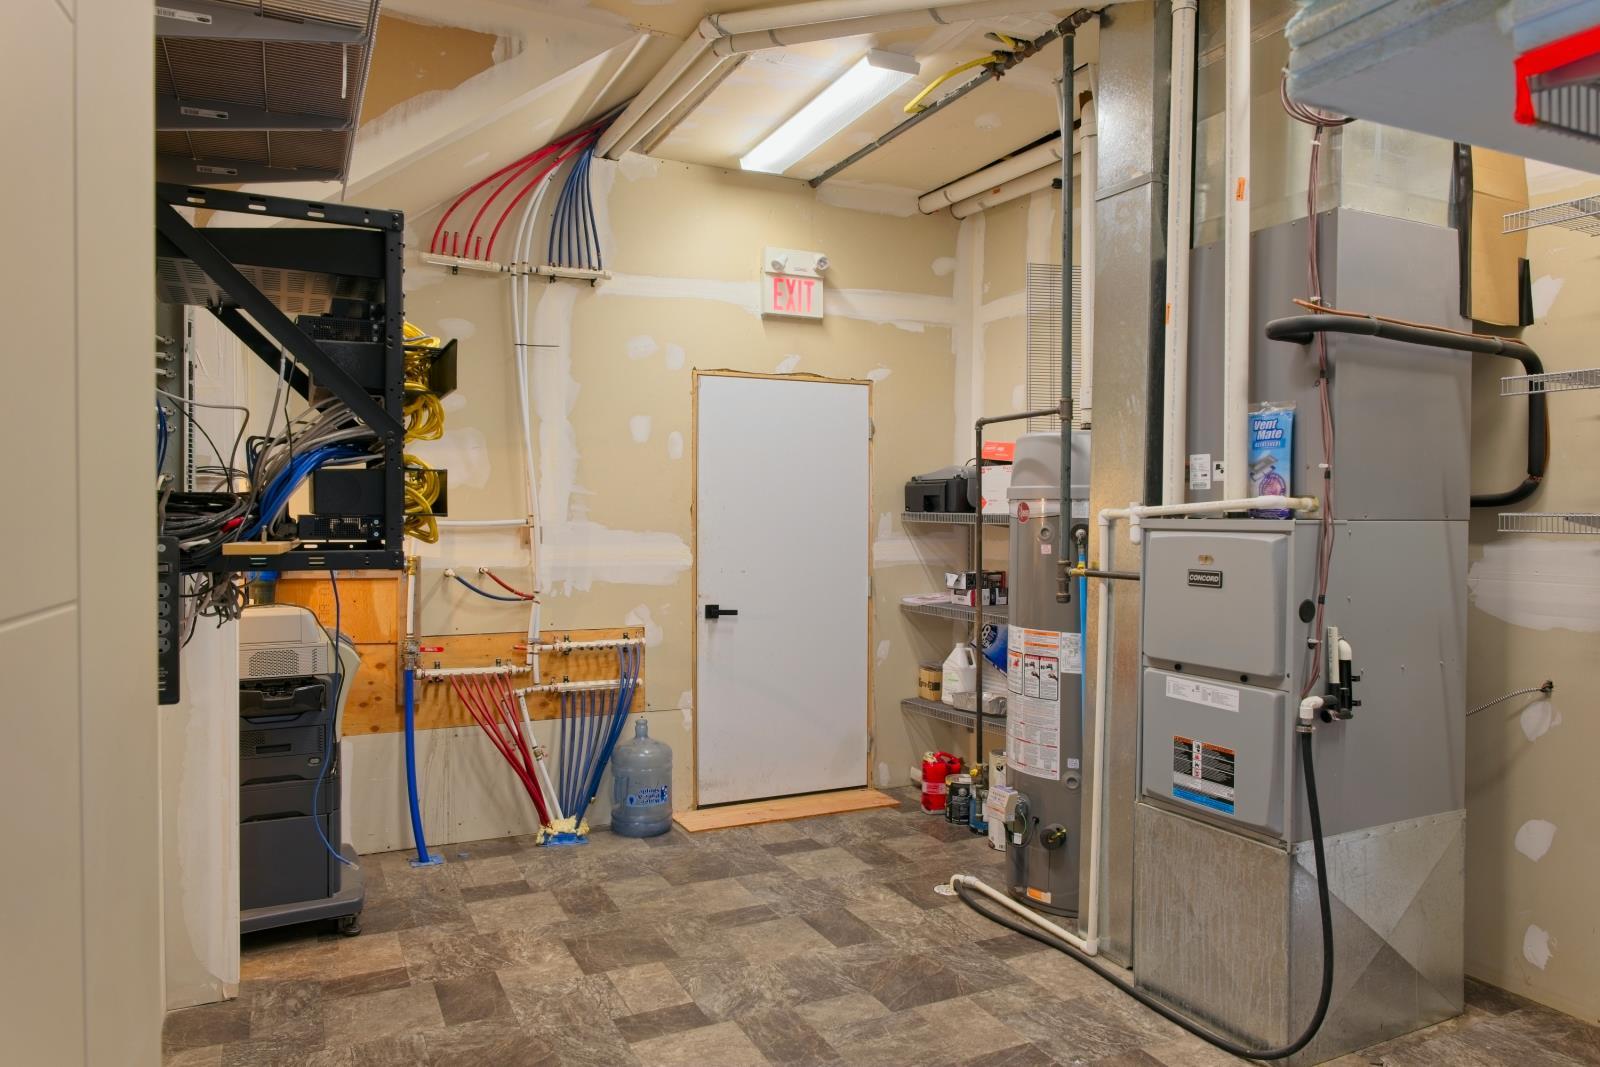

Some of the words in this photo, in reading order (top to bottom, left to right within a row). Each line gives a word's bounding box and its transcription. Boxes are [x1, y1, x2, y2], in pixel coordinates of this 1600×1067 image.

[773, 277, 814, 312] EXIT
[1254, 420, 1277, 430] Vent
[1257, 430, 1282, 440] Mate
[1189, 574, 1219, 582] CONCORD
